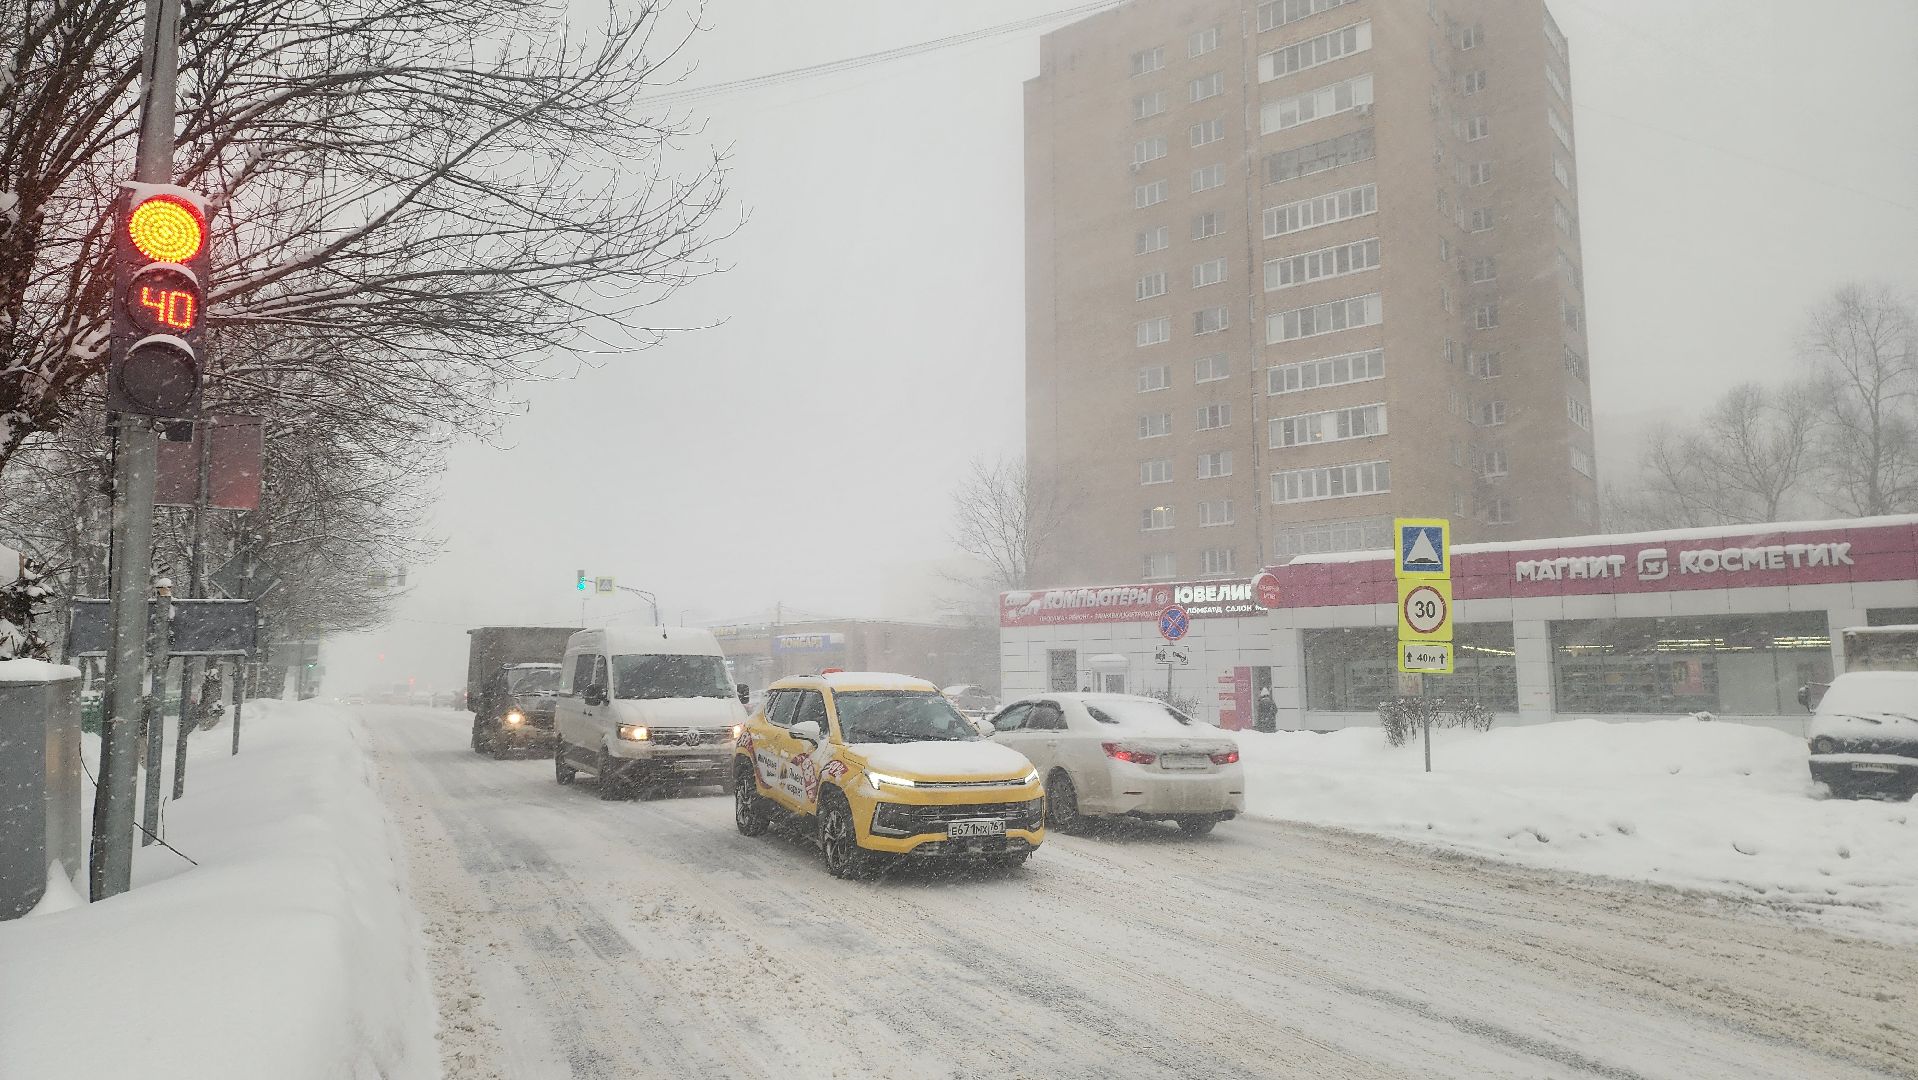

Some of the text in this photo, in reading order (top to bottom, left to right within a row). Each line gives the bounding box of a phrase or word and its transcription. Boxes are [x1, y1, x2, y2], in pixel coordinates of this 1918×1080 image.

[141, 286, 193, 329] 40
[1516, 542, 1854, 582] МАГНИТ КОСМЕТИК
[1043, 587, 1154, 609] КОМПЬЮТЕРЫ
[1414, 600, 1436, 619] 30
[989, 821, 1004, 831] 761
